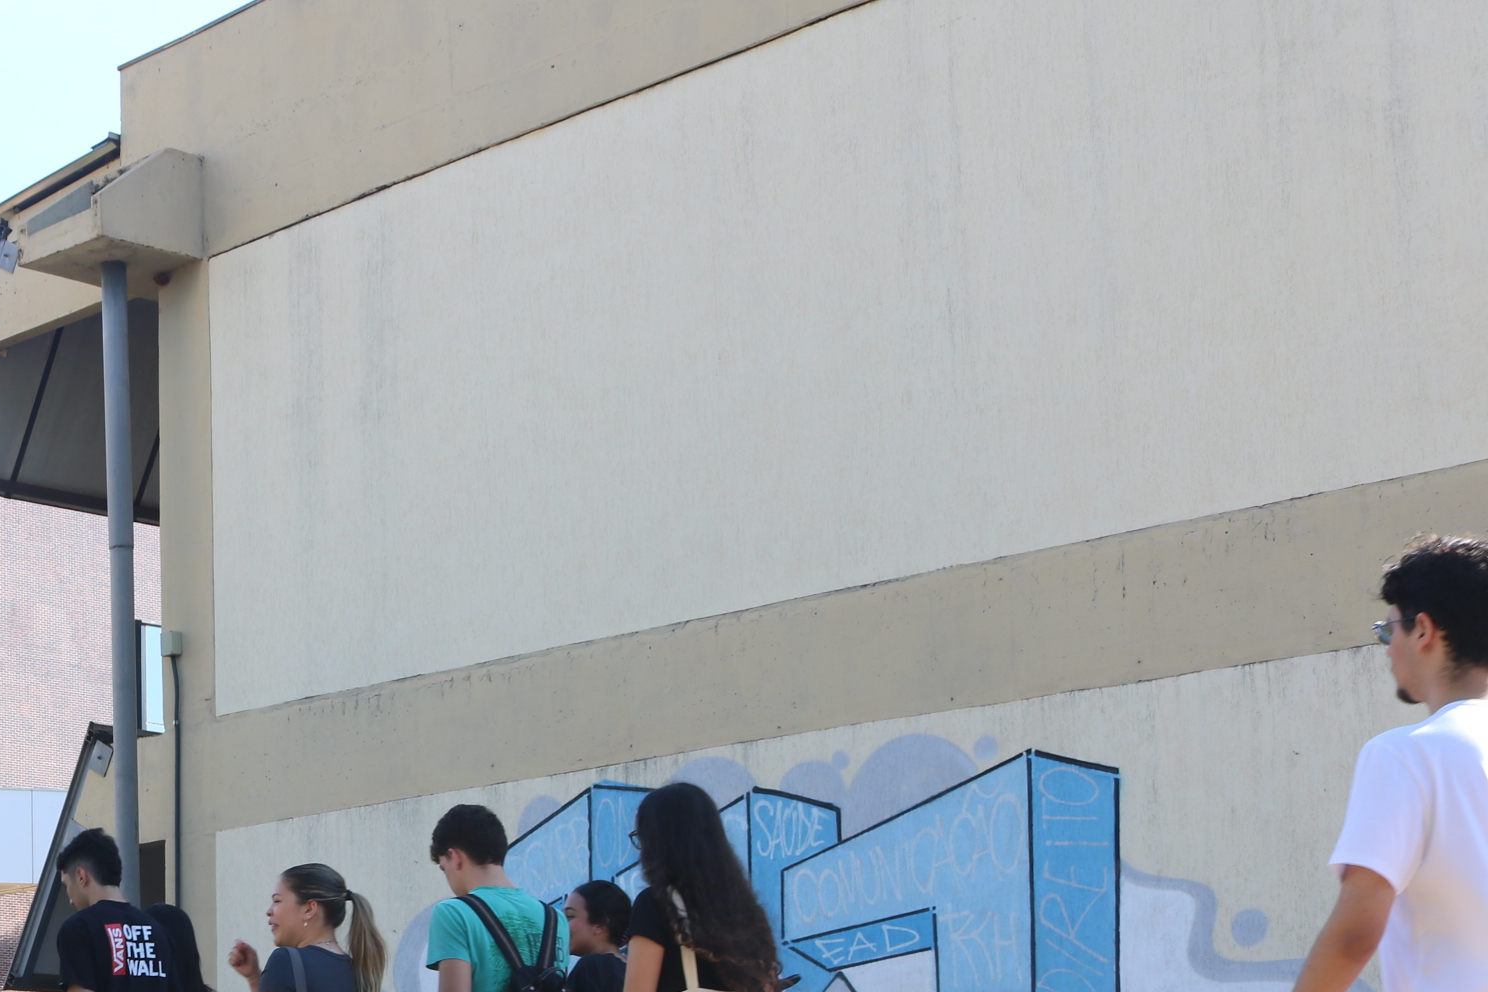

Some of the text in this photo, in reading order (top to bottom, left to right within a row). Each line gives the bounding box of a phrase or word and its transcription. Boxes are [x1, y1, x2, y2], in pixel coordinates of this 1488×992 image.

[122, 923, 153, 941] OFF
[107, 926, 125, 974] VANS
[125, 941, 157, 959] THE
[814, 923, 921, 965] EAD
[127, 958, 167, 978] WALL
